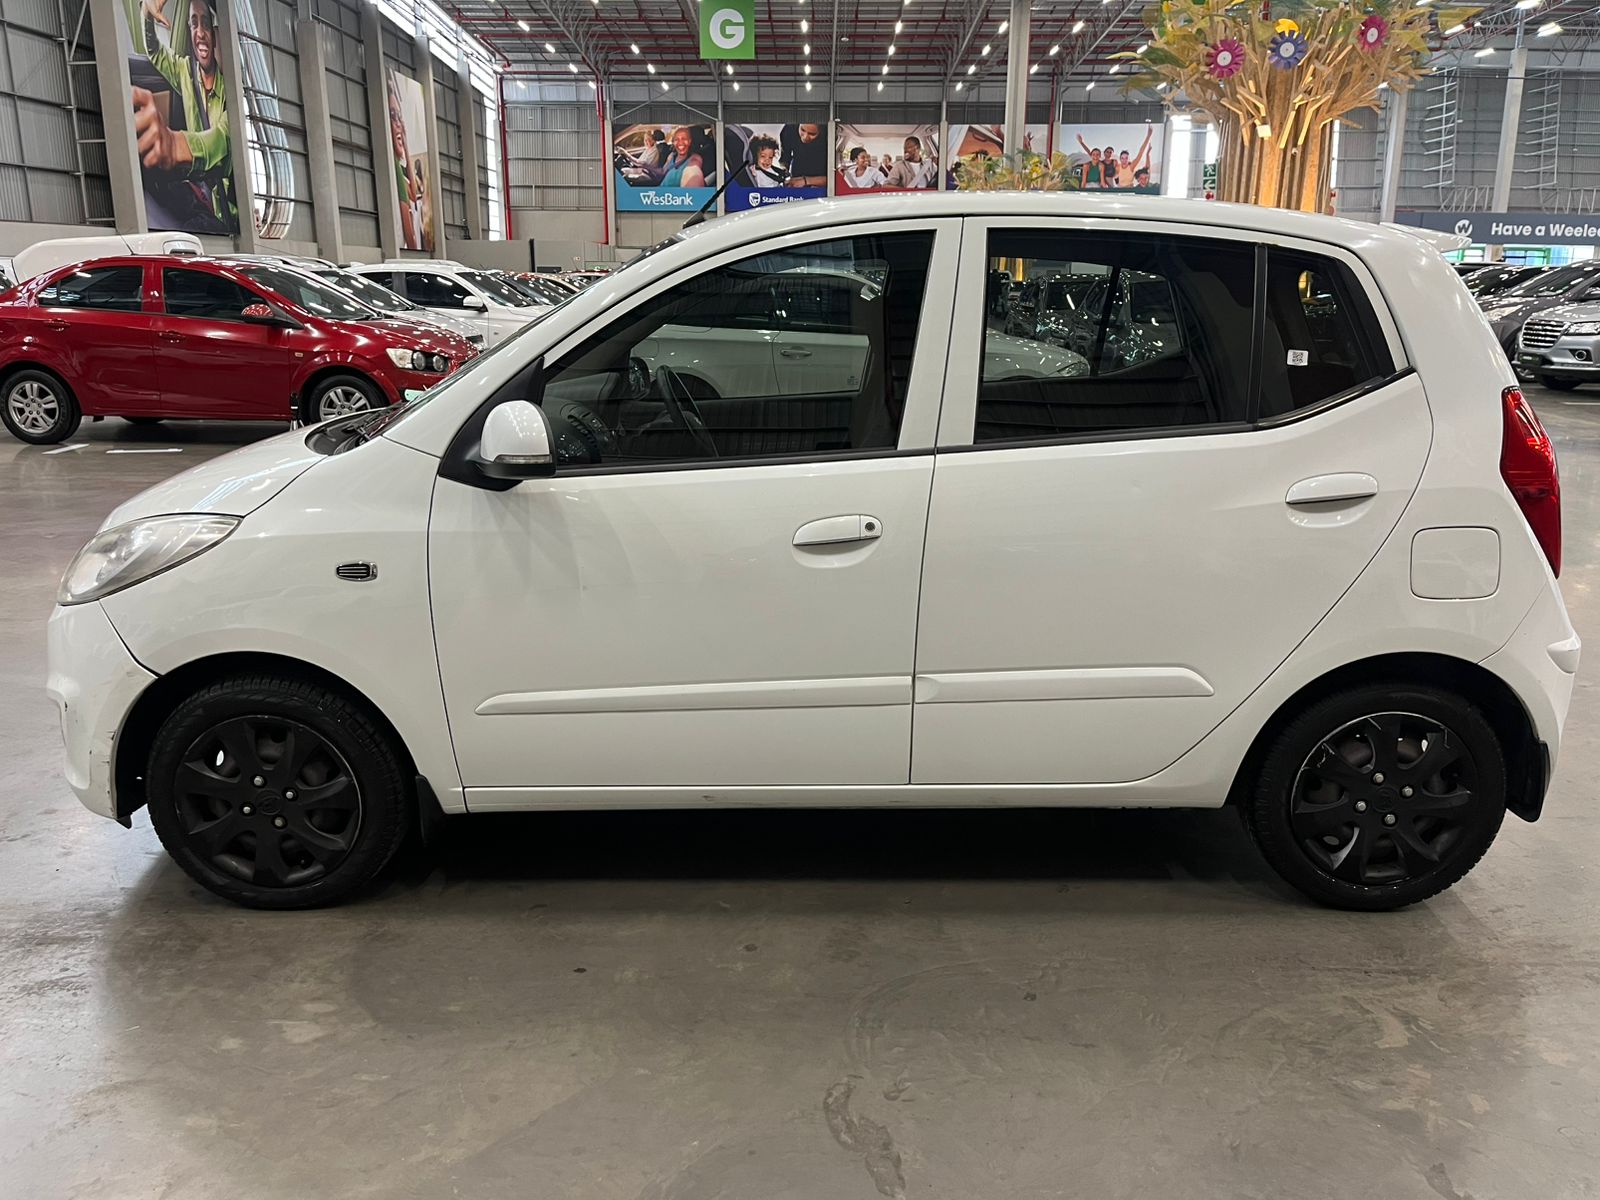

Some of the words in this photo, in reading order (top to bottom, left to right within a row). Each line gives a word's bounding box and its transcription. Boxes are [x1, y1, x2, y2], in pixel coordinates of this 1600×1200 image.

[709, 8, 745, 49] G
[640, 191, 693, 206] WesBank
[1491, 222, 1532, 236] Have
[1535, 225, 1546, 236] a
